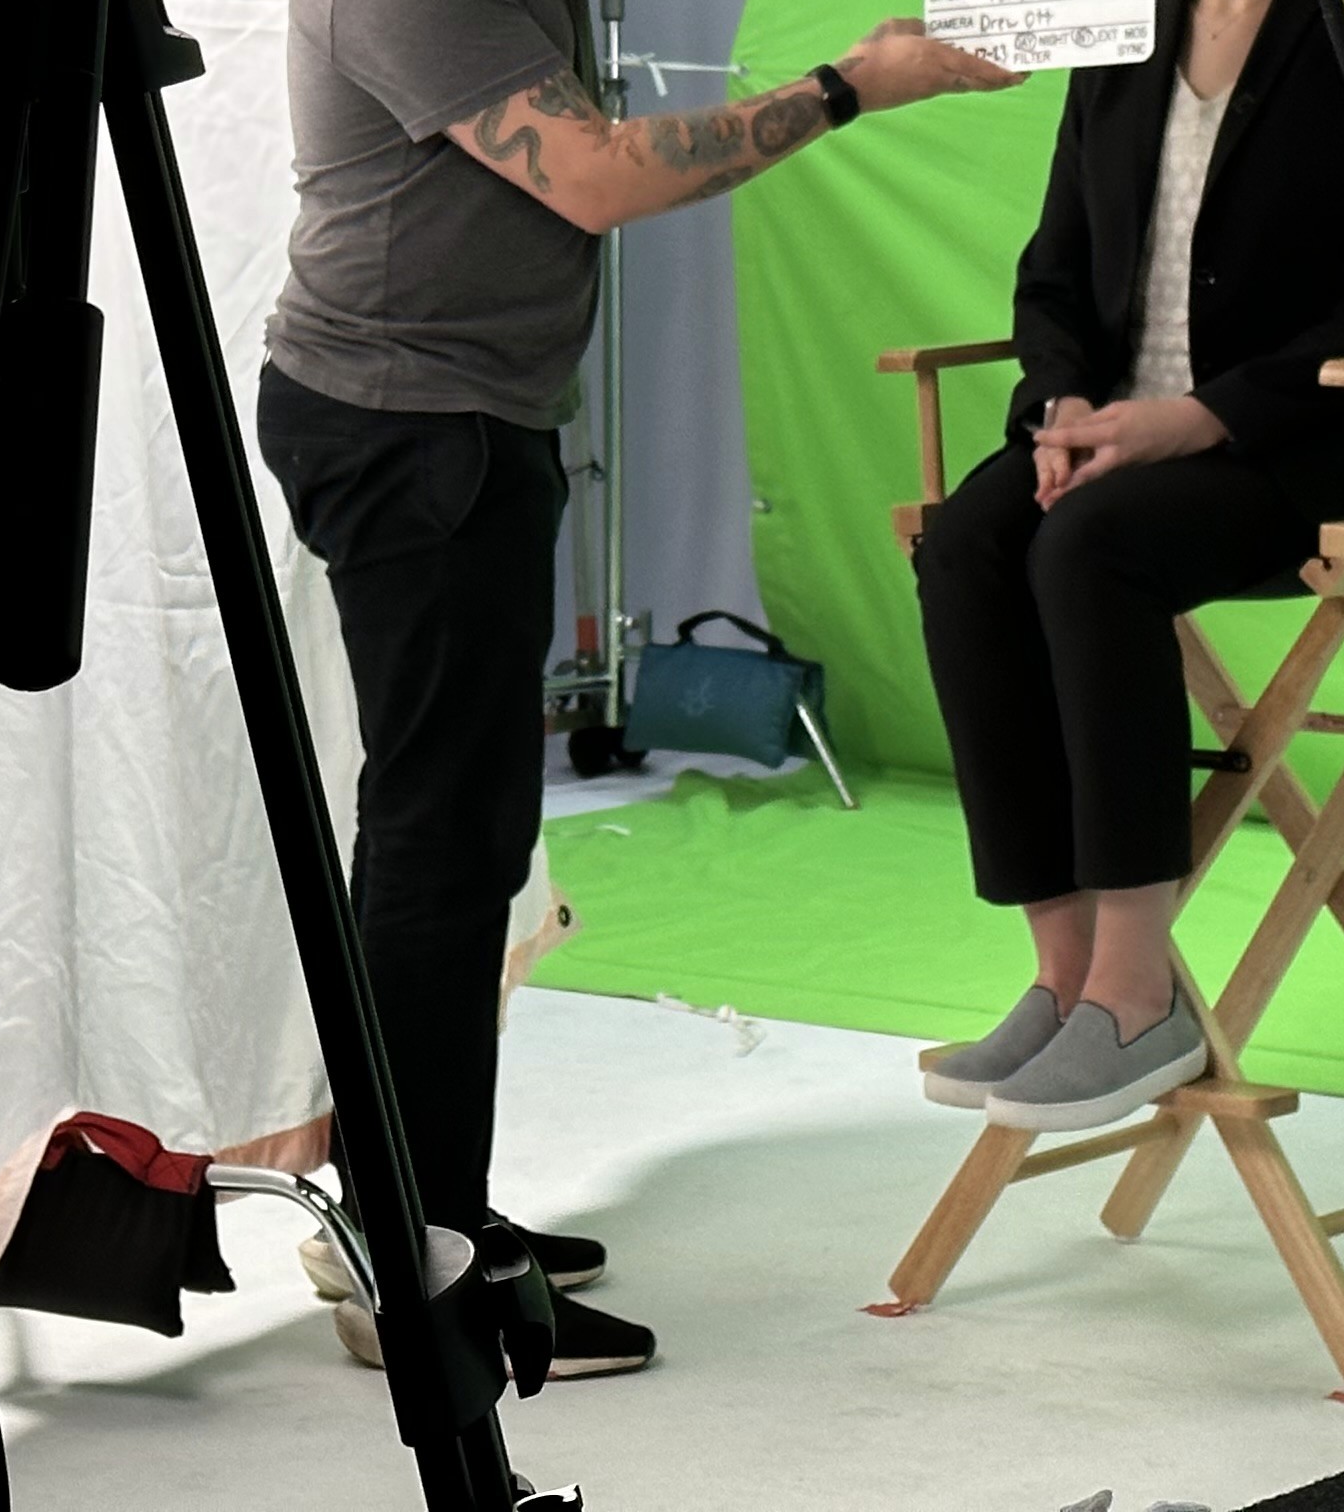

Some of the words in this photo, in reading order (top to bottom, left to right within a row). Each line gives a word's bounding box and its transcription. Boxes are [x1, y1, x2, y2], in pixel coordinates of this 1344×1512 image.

[928, 16, 975, 33] CAMERA
[1013, 49, 1052, 65] FILTER
[1117, 42, 1147, 56] SYNC
